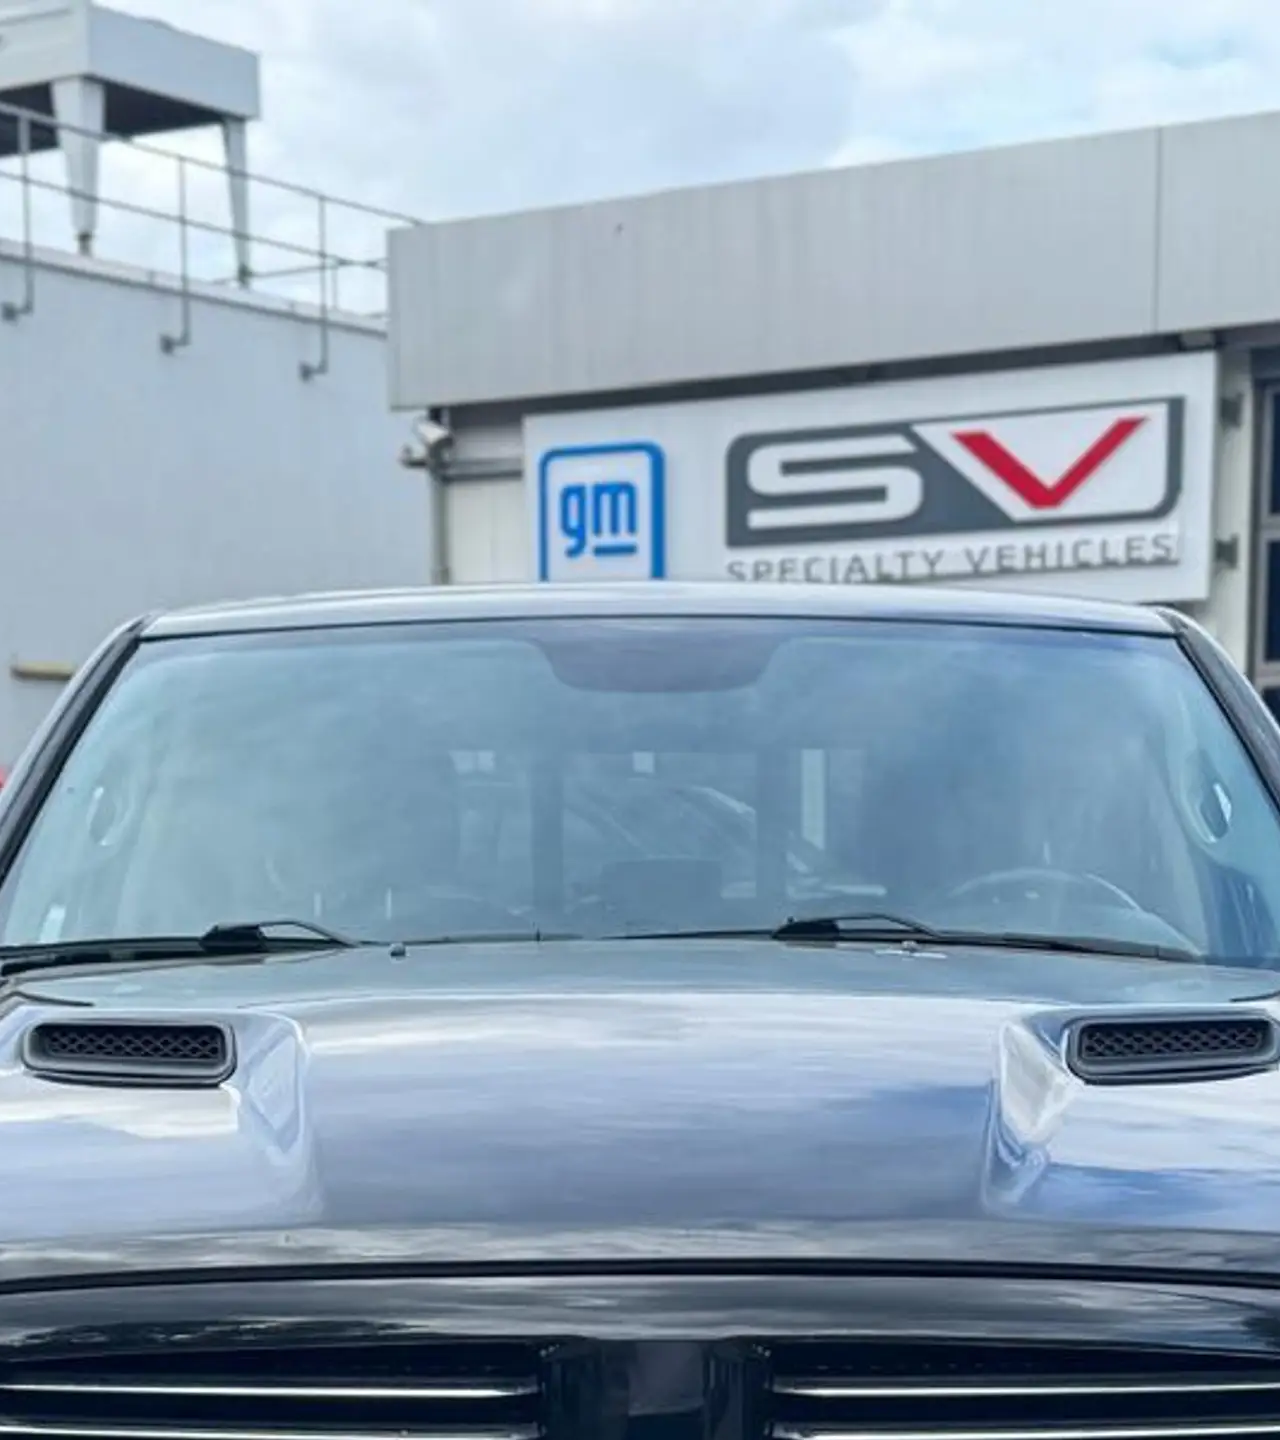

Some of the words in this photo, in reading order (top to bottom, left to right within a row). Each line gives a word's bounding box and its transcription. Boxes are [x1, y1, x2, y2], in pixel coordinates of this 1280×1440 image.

[560, 480, 640, 559] gm
[726, 549, 945, 584] SPECIALTY
[963, 534, 1179, 574] VEHICLES
